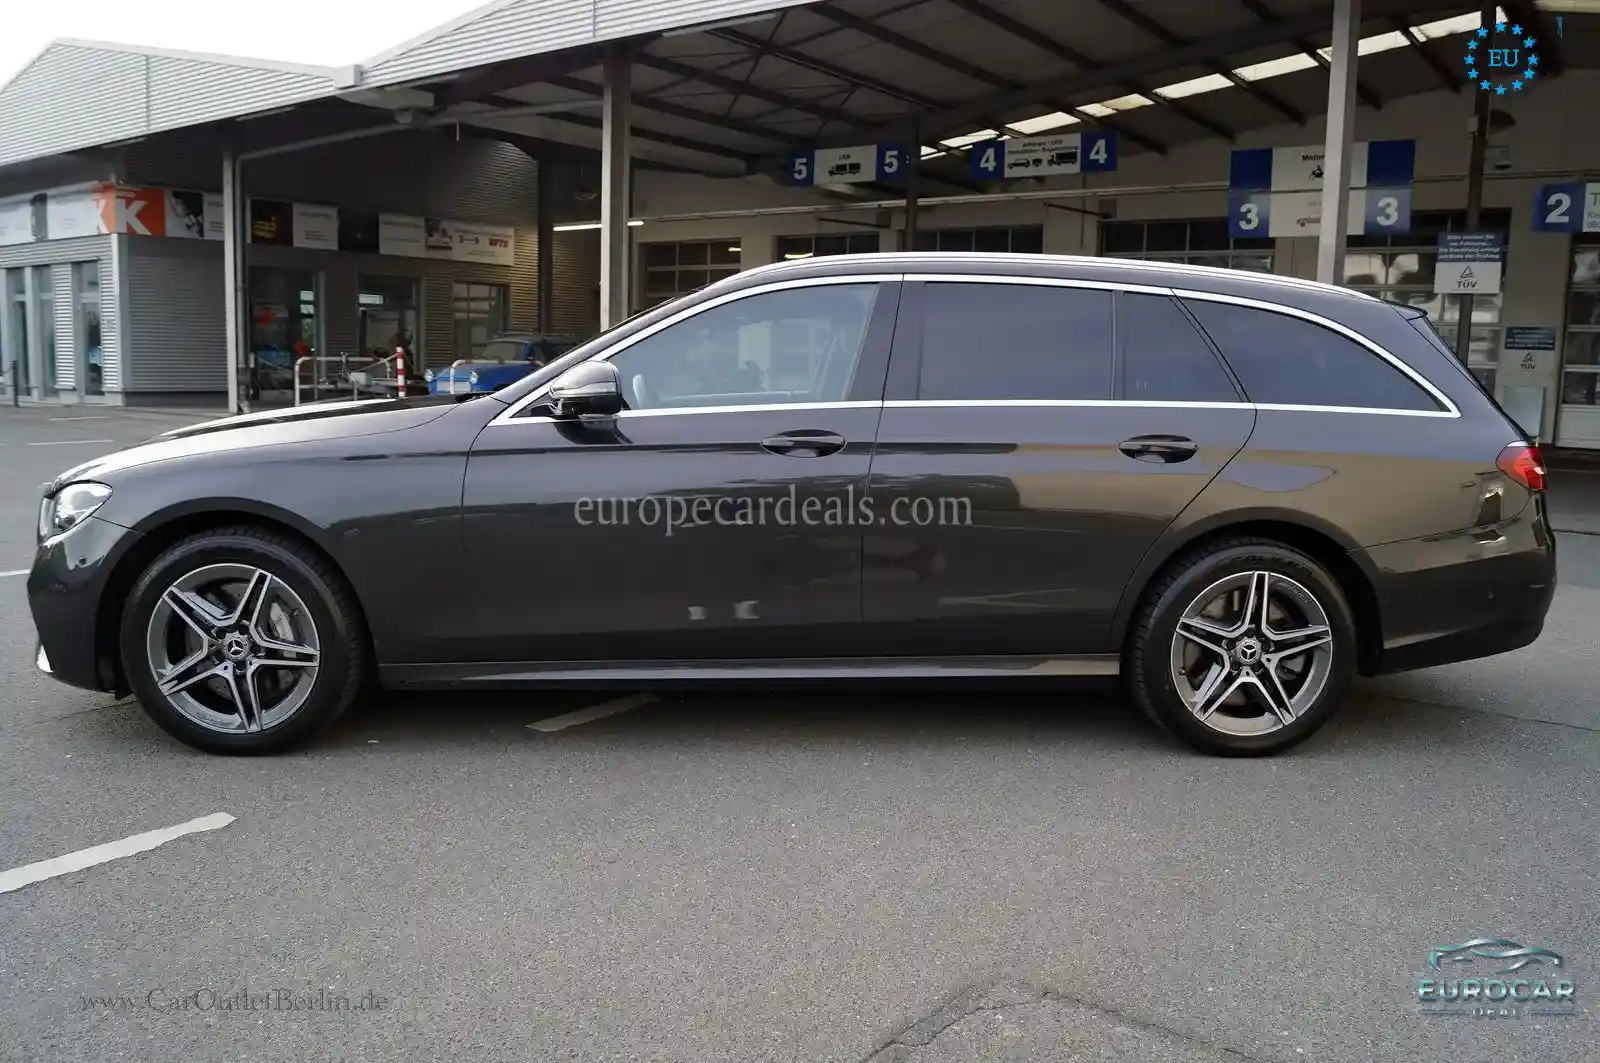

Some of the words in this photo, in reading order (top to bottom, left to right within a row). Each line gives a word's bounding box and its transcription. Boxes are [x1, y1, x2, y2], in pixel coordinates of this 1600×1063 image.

[884, 151, 898, 173] 5
[980, 148, 996, 171] 4
[1090, 139, 1107, 164] 4
[1301, 153, 1325, 162] Motor
[794, 158, 807, 180] 5
[115, 199, 150, 235] K
[1239, 203, 1259, 230] 3
[1376, 197, 1398, 226] 3
[1545, 192, 1571, 223] 2
[1456, 279, 1477, 288] TÜV
[1520, 362, 1536, 370] TÜV
